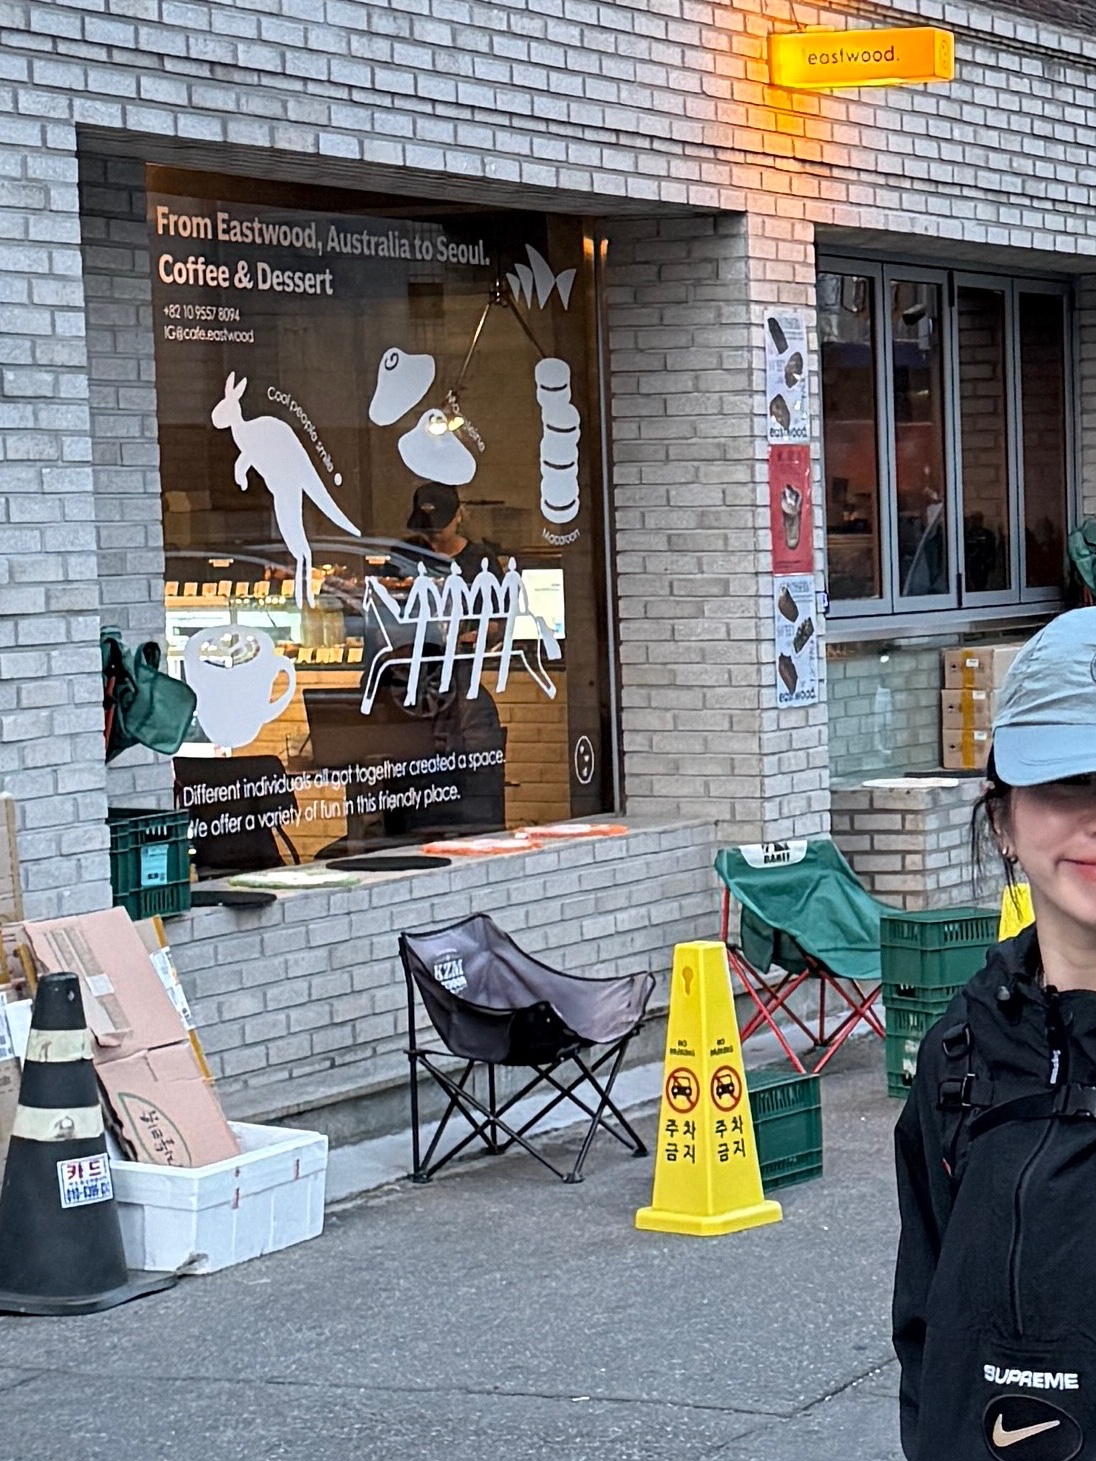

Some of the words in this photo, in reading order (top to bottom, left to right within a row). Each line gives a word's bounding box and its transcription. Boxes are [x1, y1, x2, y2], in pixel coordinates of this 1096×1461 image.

[808, 46, 900, 65] eastwood.
[156, 206, 212, 239] From
[217, 212, 323, 256] Eastwood,
[327, 225, 411, 259] Australia
[414, 234, 433, 260] to
[437, 236, 490, 265] Seoul.
[158, 254, 230, 287] Coffee
[233, 260, 254, 289] &
[257, 262, 334, 295] Dessert
[163, 304, 181, 319] +82
[183, 305, 194, 320] 10
[195, 306, 216, 321] 9557
[267, 386, 291, 406] Cool
[183, 779, 241, 807] Different
[243, 771, 311, 799] individuals
[314, 767, 328, 787] all
[331, 764, 353, 791] got
[355, 760, 407, 786] together
[409, 752, 455, 776] created
[458, 755, 467, 769] a
[468, 749, 506, 772] space.
[211, 812, 243, 836] offer
[245, 816, 256, 831] a
[257, 804, 302, 828] variety
[304, 800, 318, 822] of
[320, 799, 341, 819] fun
[343, 795, 354, 816] in
[357, 792, 376, 814] this
[379, 786, 421, 812] friendly
[423, 783, 461, 809] place.
[665, 1119, 696, 1141] 주차
[715, 1115, 743, 1139] 주차
[665, 1142, 696, 1164] 금지
[717, 1138, 746, 1162] 금지
[67, 1160, 102, 1180] 카드
[983, 1364, 1080, 1391] SUPREME
